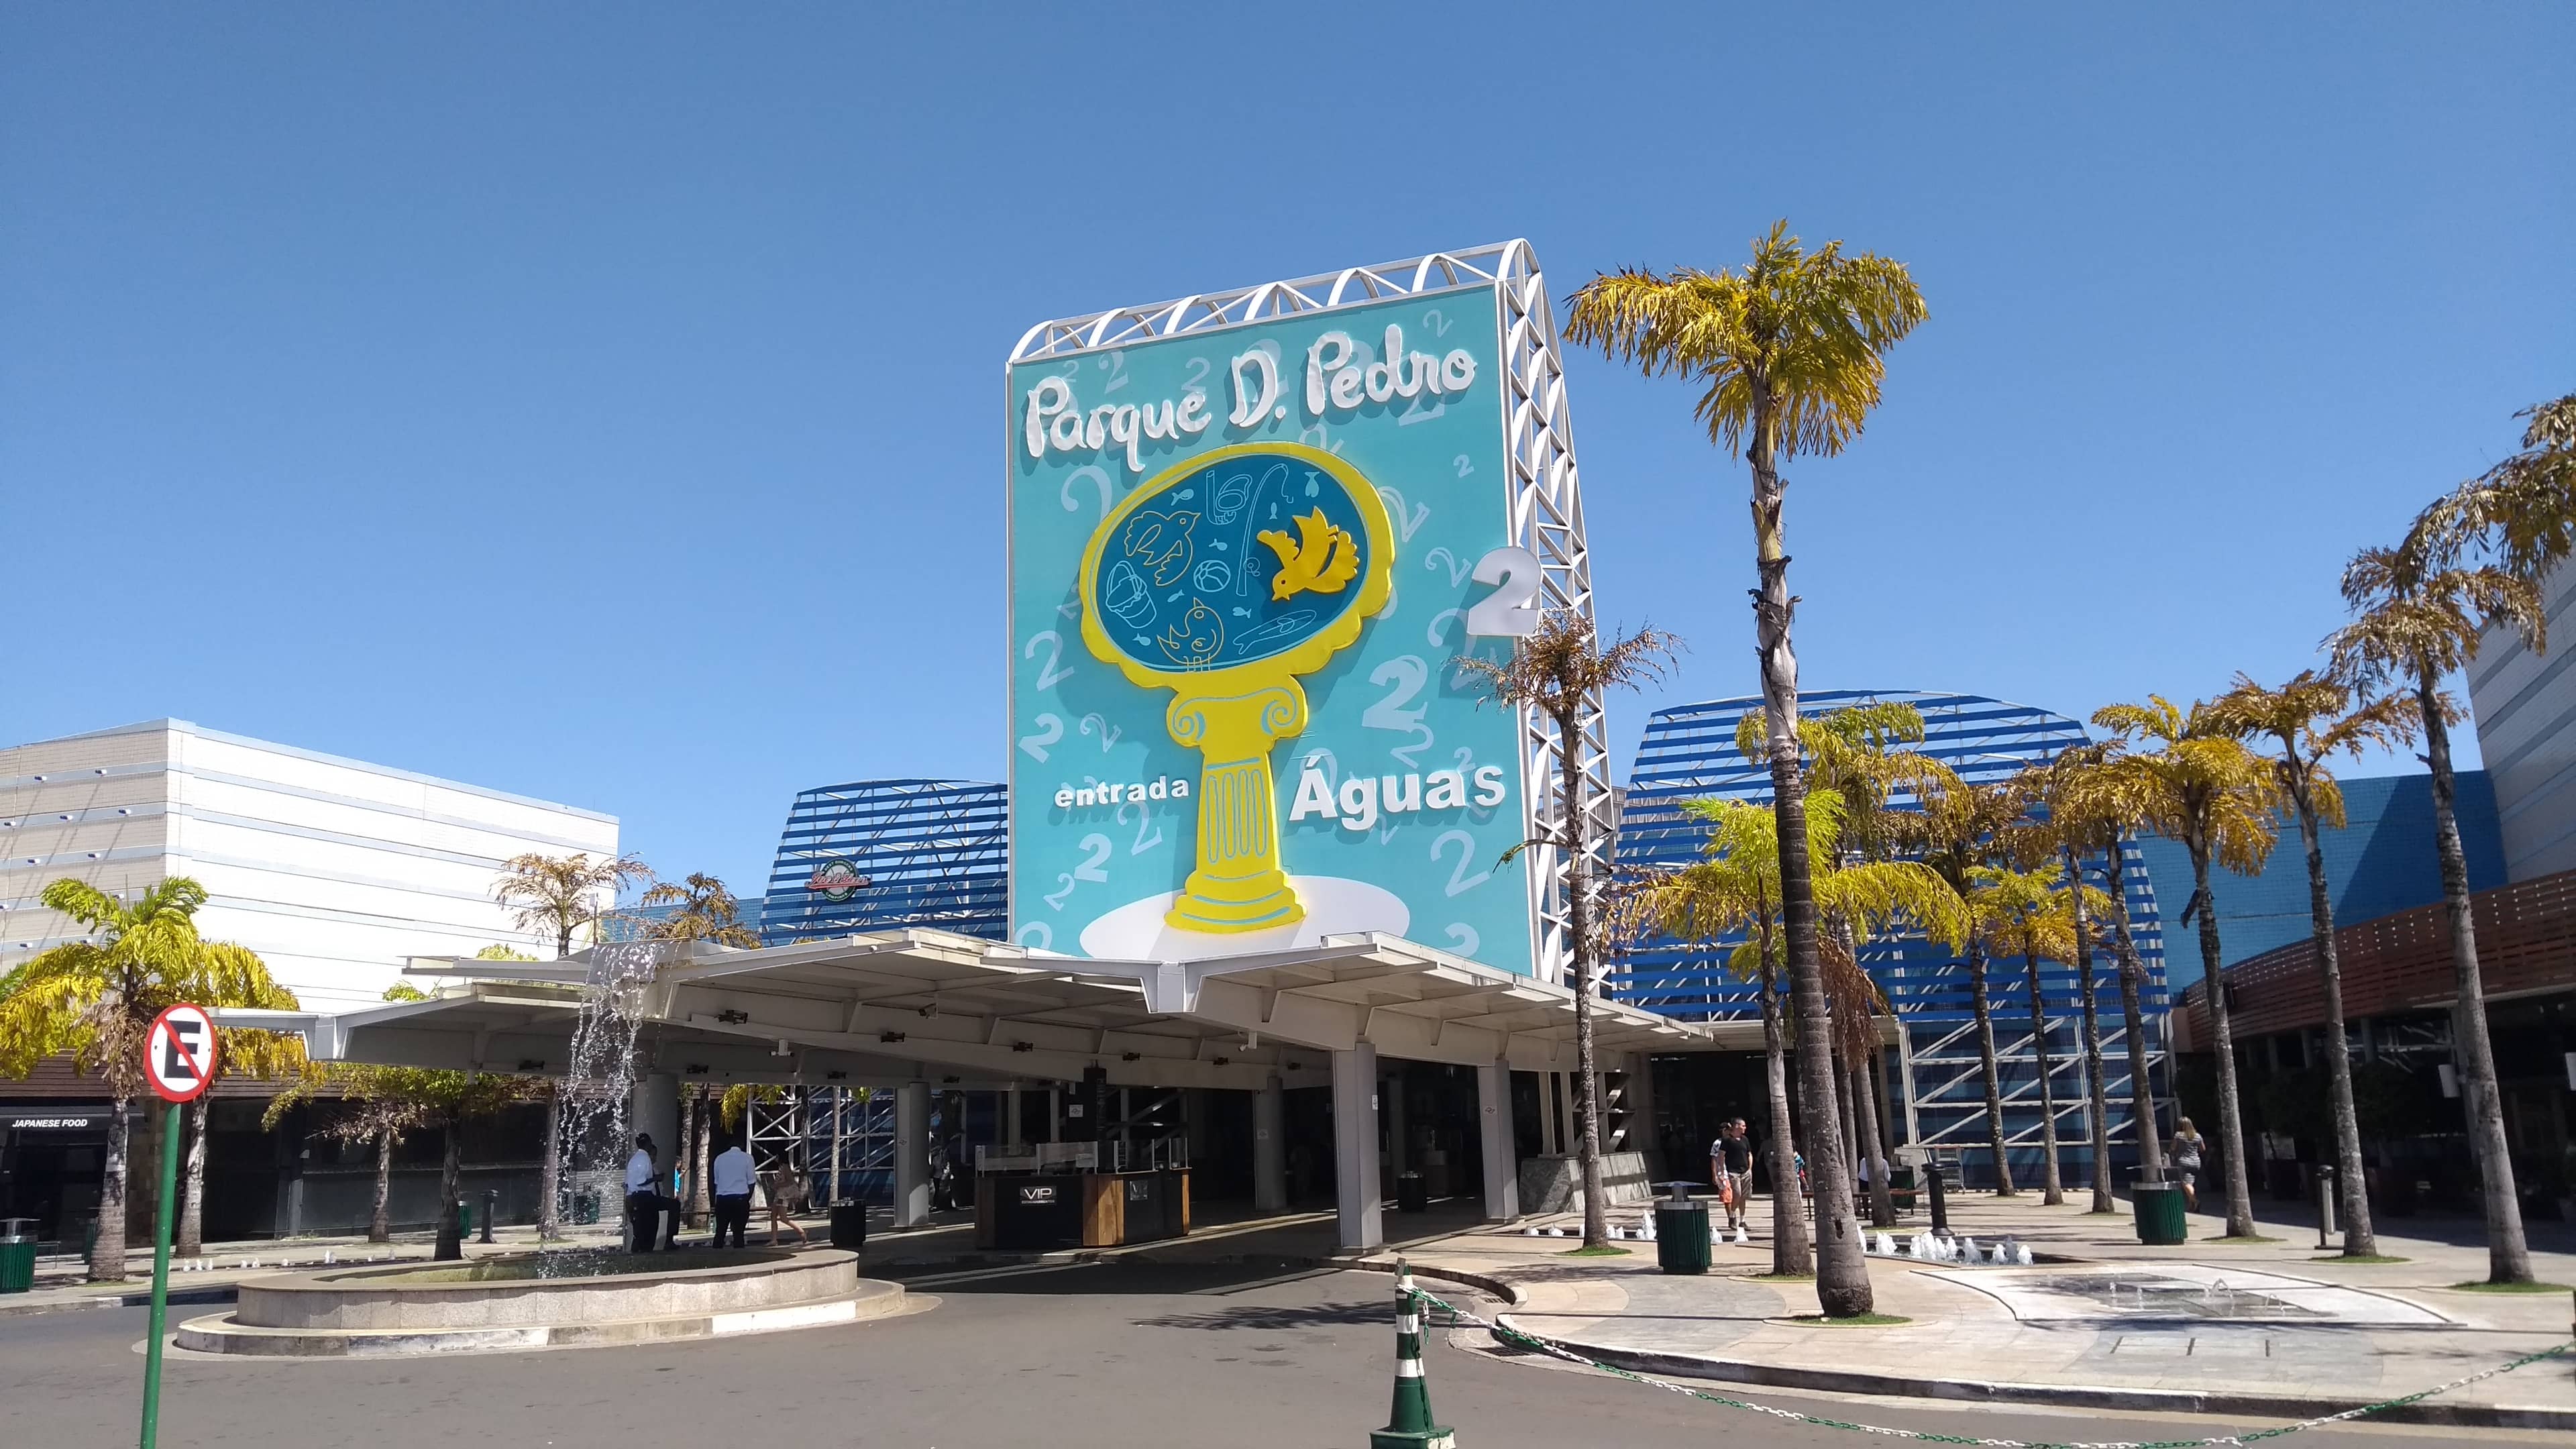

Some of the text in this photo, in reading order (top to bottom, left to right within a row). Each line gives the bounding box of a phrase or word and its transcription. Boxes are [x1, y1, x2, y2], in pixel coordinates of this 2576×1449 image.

[1026, 376, 1212, 472] Parque
[1228, 348, 1286, 428] D.
[1307, 323, 1477, 416] Pedro
[1466, 545, 1542, 636] 2
[1055, 775, 1189, 808] entrada
[1289, 755, 1505, 831] Águas
[164, 1020, 201, 1079] E
[12, 1119, 88, 1128] JAPANESE FOOD
[1024, 1187, 1053, 1199] VIP
